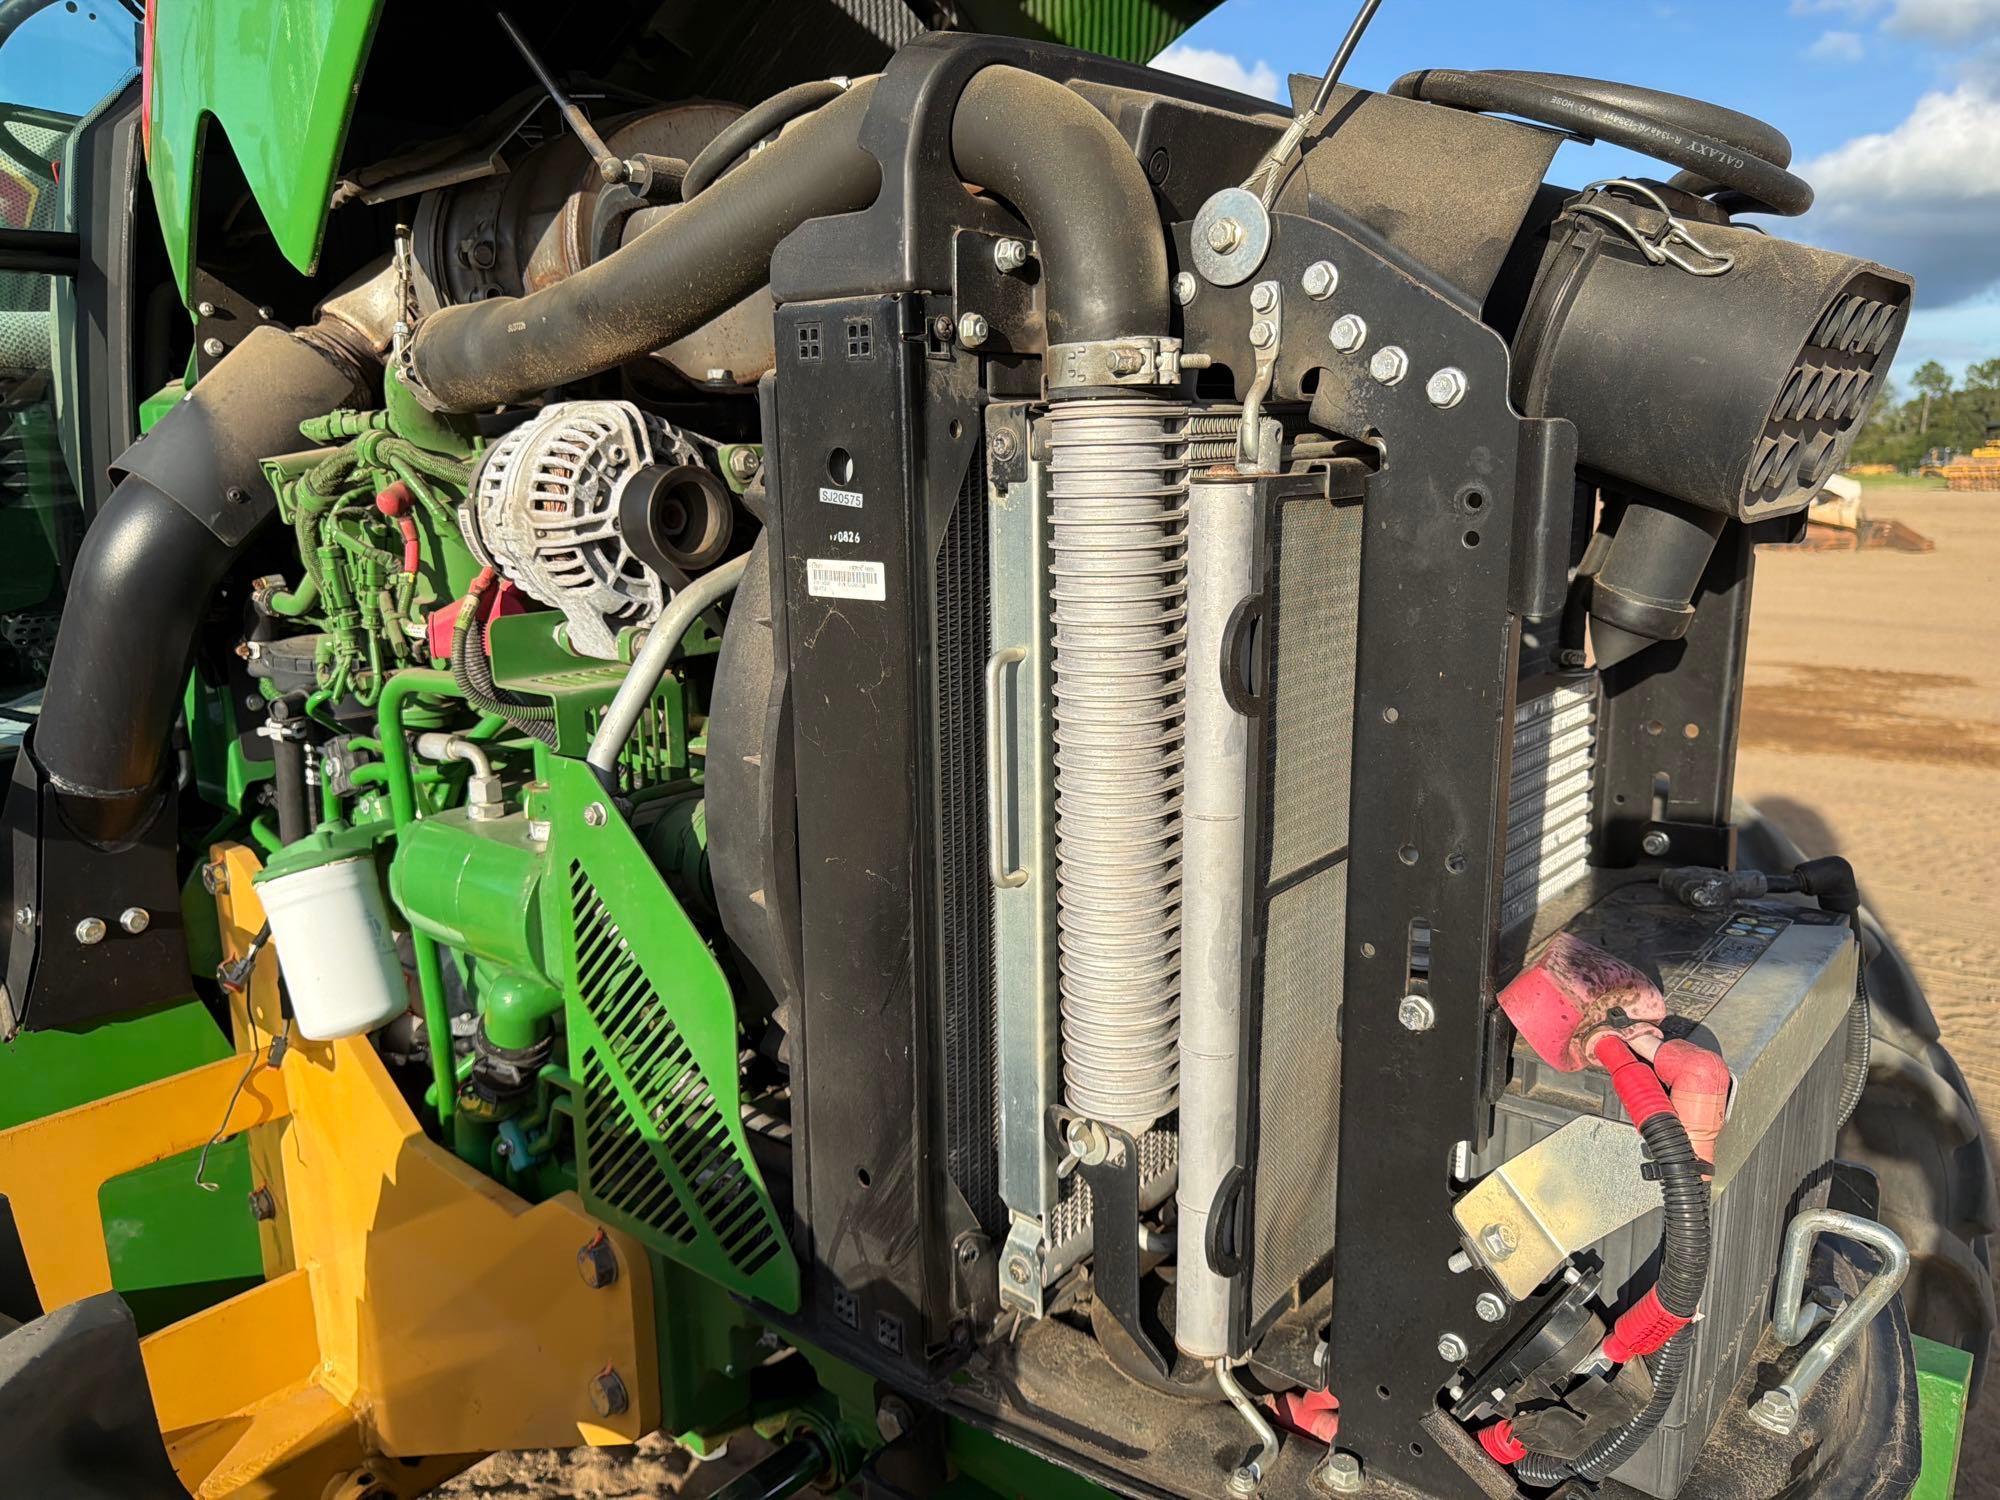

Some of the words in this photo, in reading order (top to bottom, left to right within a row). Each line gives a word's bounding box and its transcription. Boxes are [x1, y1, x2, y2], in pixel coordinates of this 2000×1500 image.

[1551, 95, 1574, 109] HOSE
[1579, 103, 1599, 116] A/C
[1602, 110, 1682, 145] R-134a/R-1234yf
[1686, 140, 1744, 170] GALAXY
[822, 490, 861, 507] SJ20575
